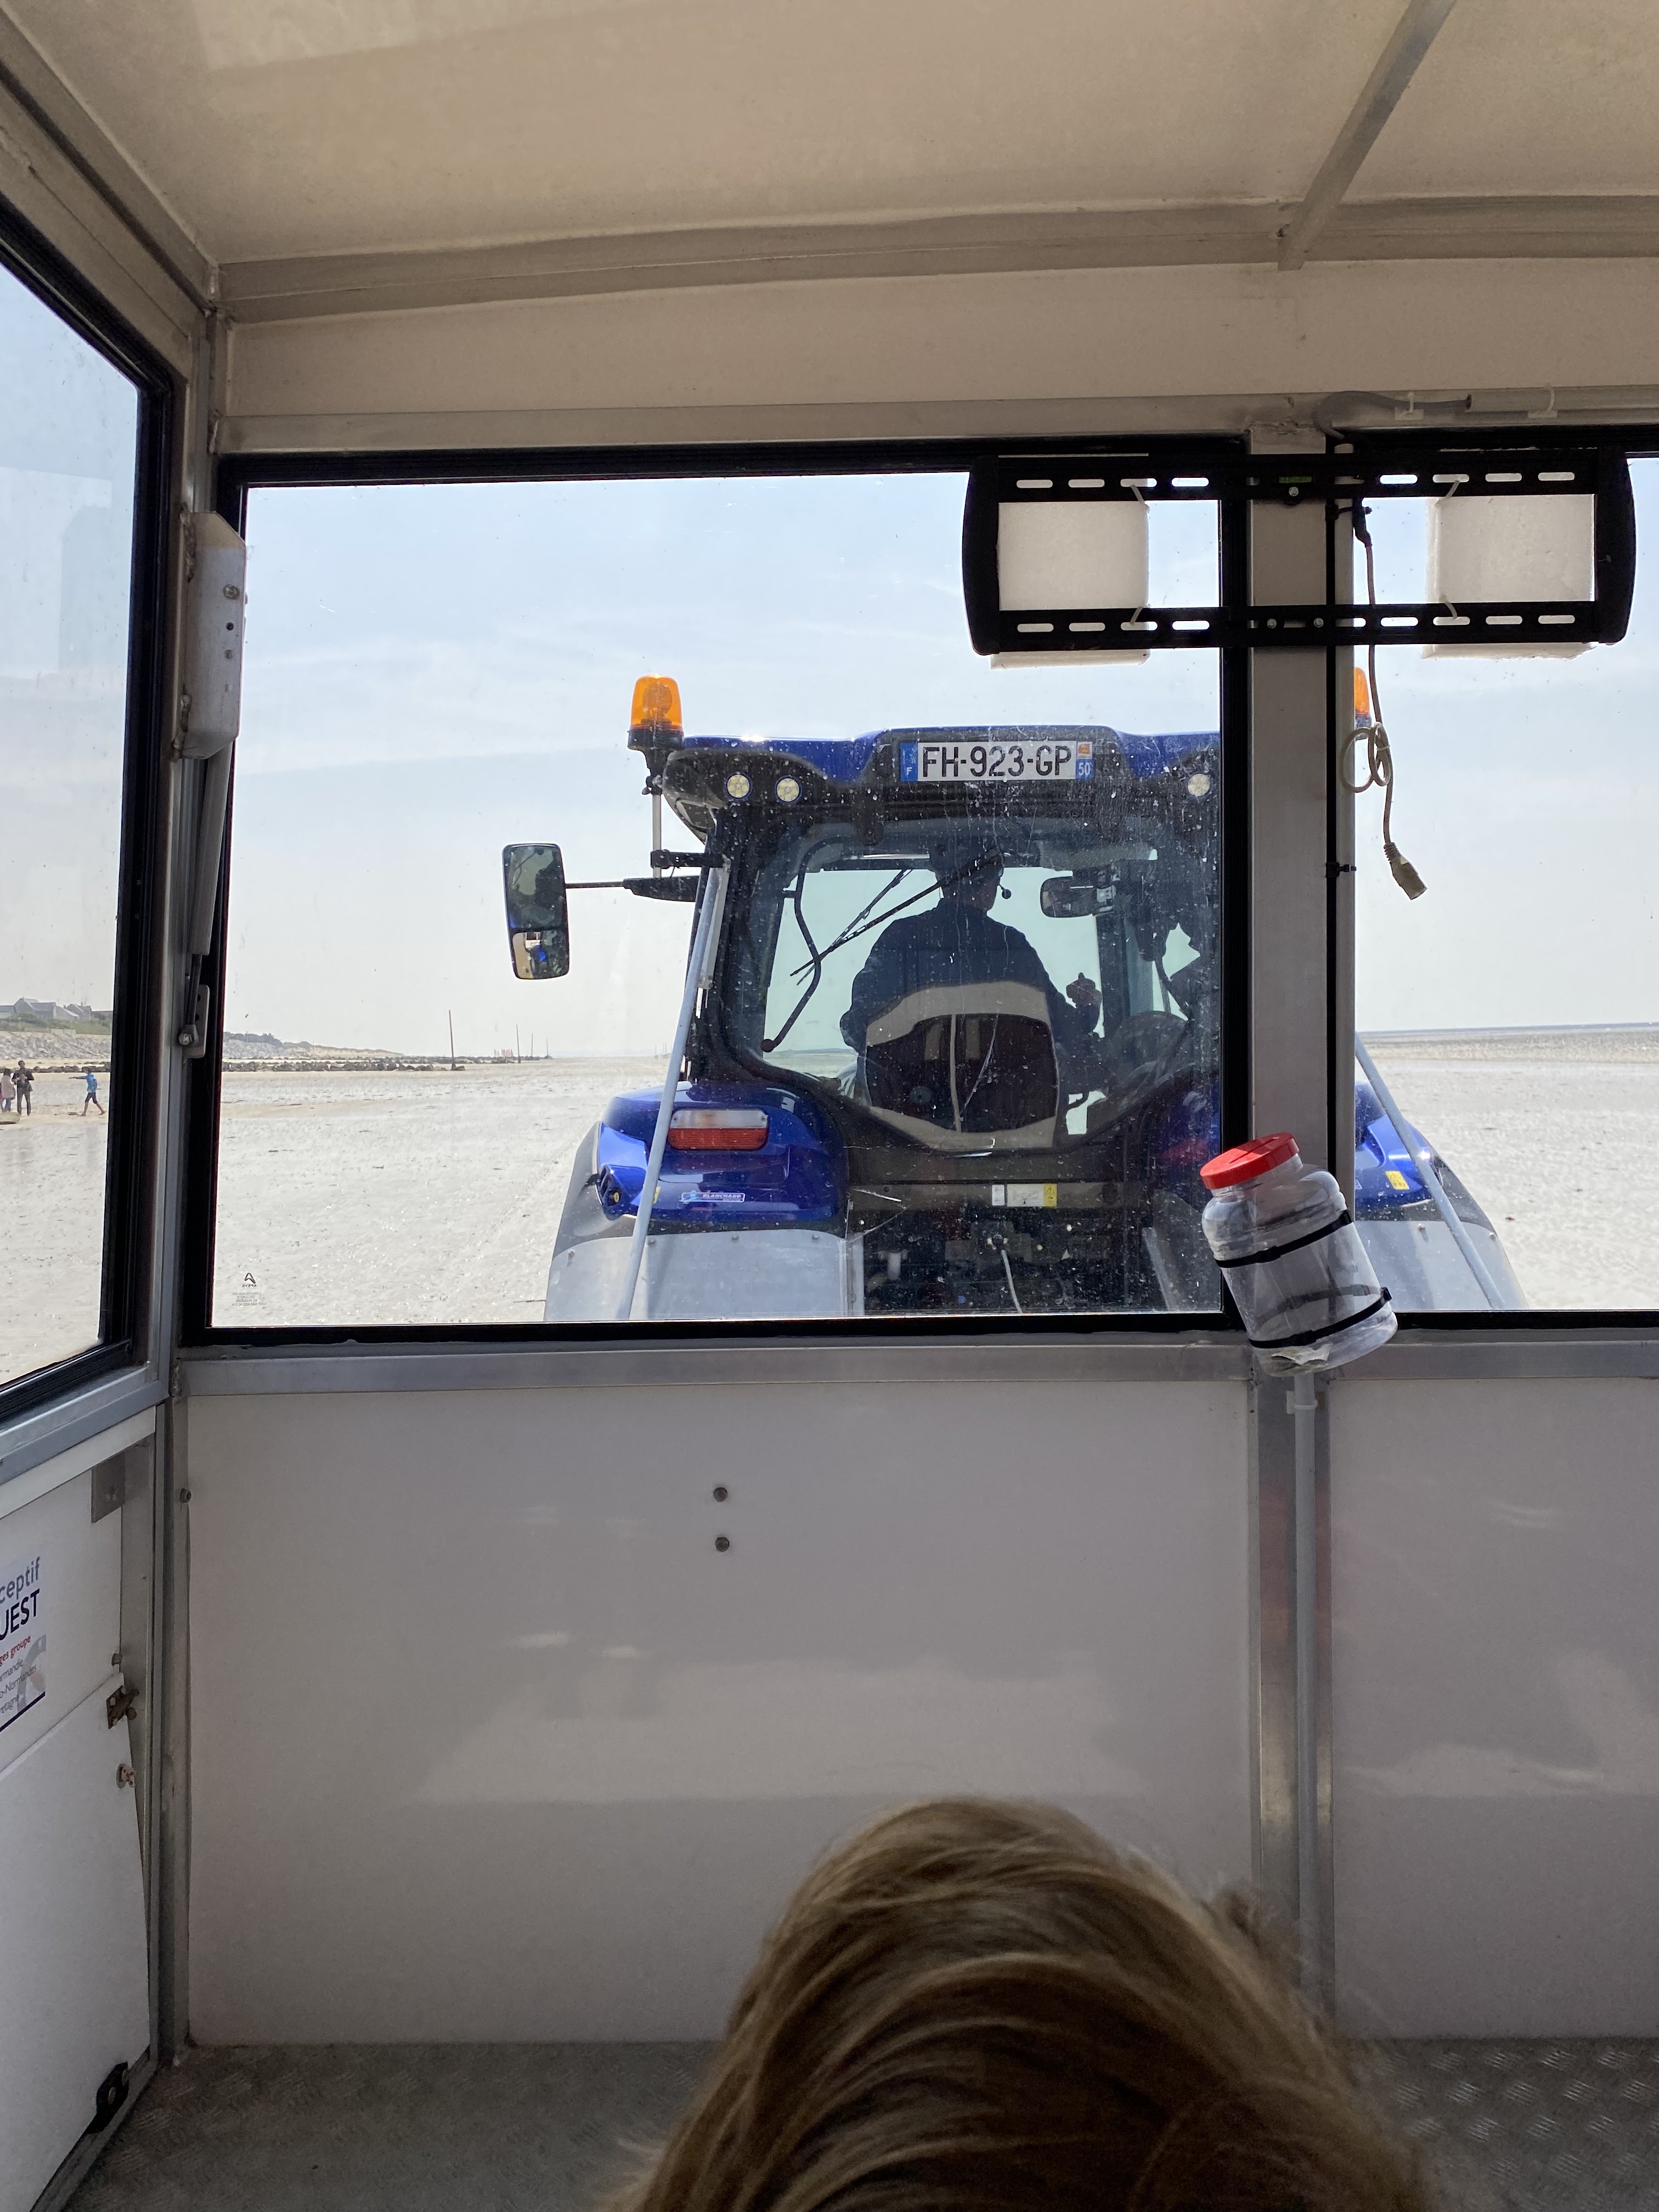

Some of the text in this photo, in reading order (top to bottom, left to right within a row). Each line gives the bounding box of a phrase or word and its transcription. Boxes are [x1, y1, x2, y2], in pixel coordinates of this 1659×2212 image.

[922, 745, 1072, 777] FH-923-GP
[1078, 761, 1091, 777] 50
[906, 766, 913, 776] F
[10, 1635, 31, 1658] groupe
